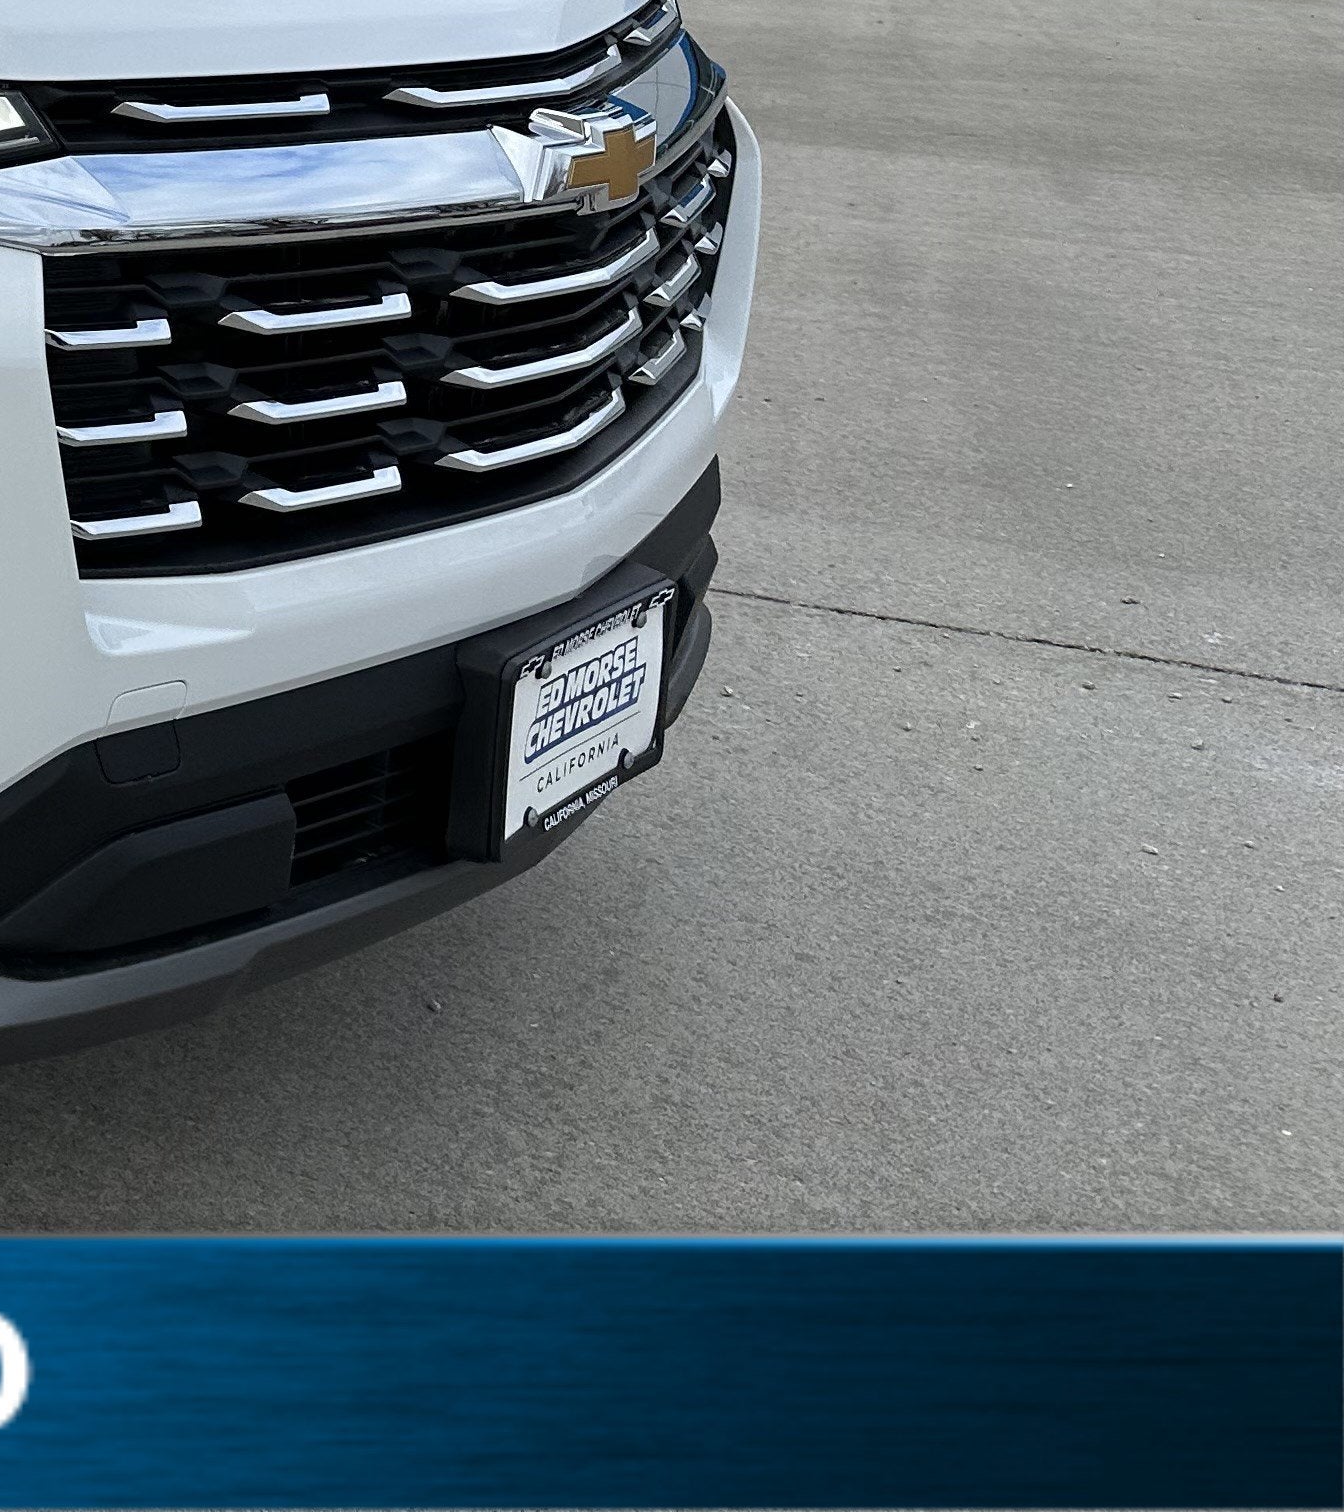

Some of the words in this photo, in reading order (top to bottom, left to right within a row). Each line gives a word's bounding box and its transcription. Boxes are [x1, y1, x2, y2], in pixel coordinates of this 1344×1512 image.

[525, 664, 646, 760] CHEVROLET
[536, 675, 566, 718] ED
[563, 637, 638, 704] MORSE
[536, 731, 620, 794] CALIFORNIA
